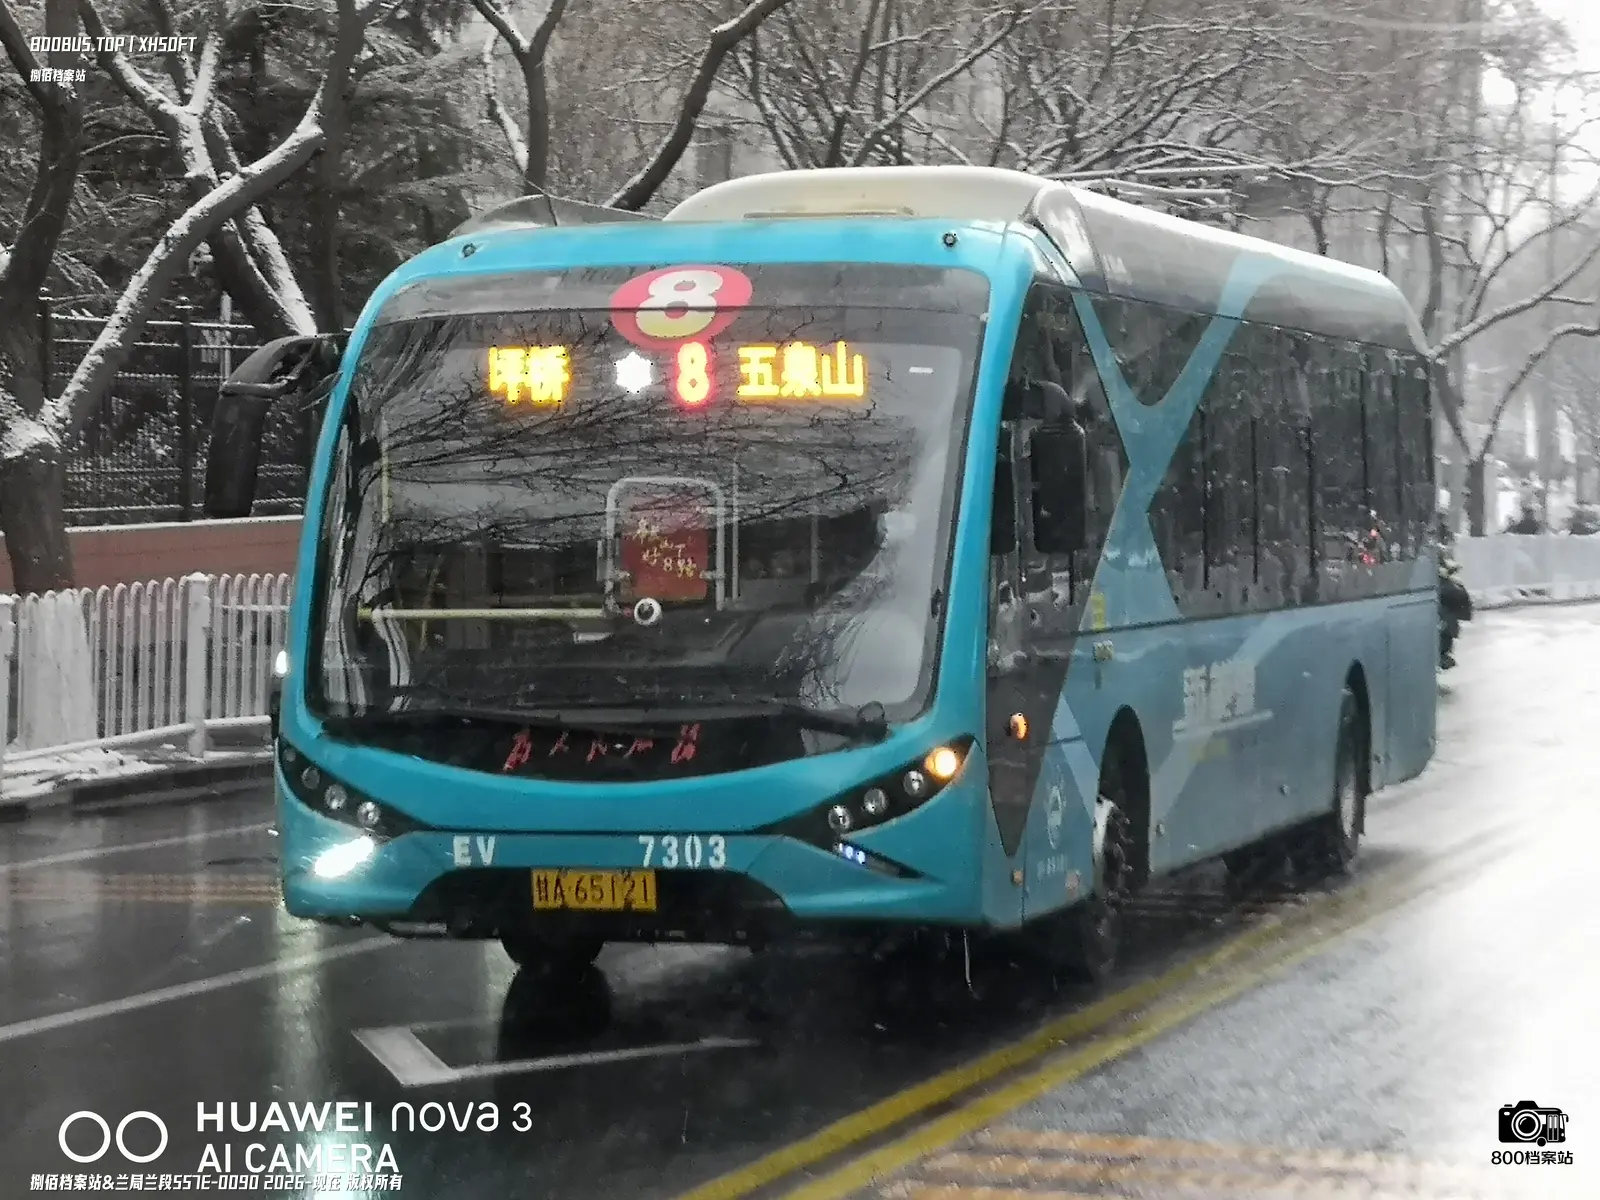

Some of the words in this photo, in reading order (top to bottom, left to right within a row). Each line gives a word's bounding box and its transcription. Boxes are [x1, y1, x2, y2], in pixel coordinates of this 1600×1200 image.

[636, 269, 722, 338] 8
[677, 342, 709, 403] 8
[737, 341, 865, 398] 五泉山
[453, 836, 496, 867] EV
[638, 835, 727, 869] 7303
